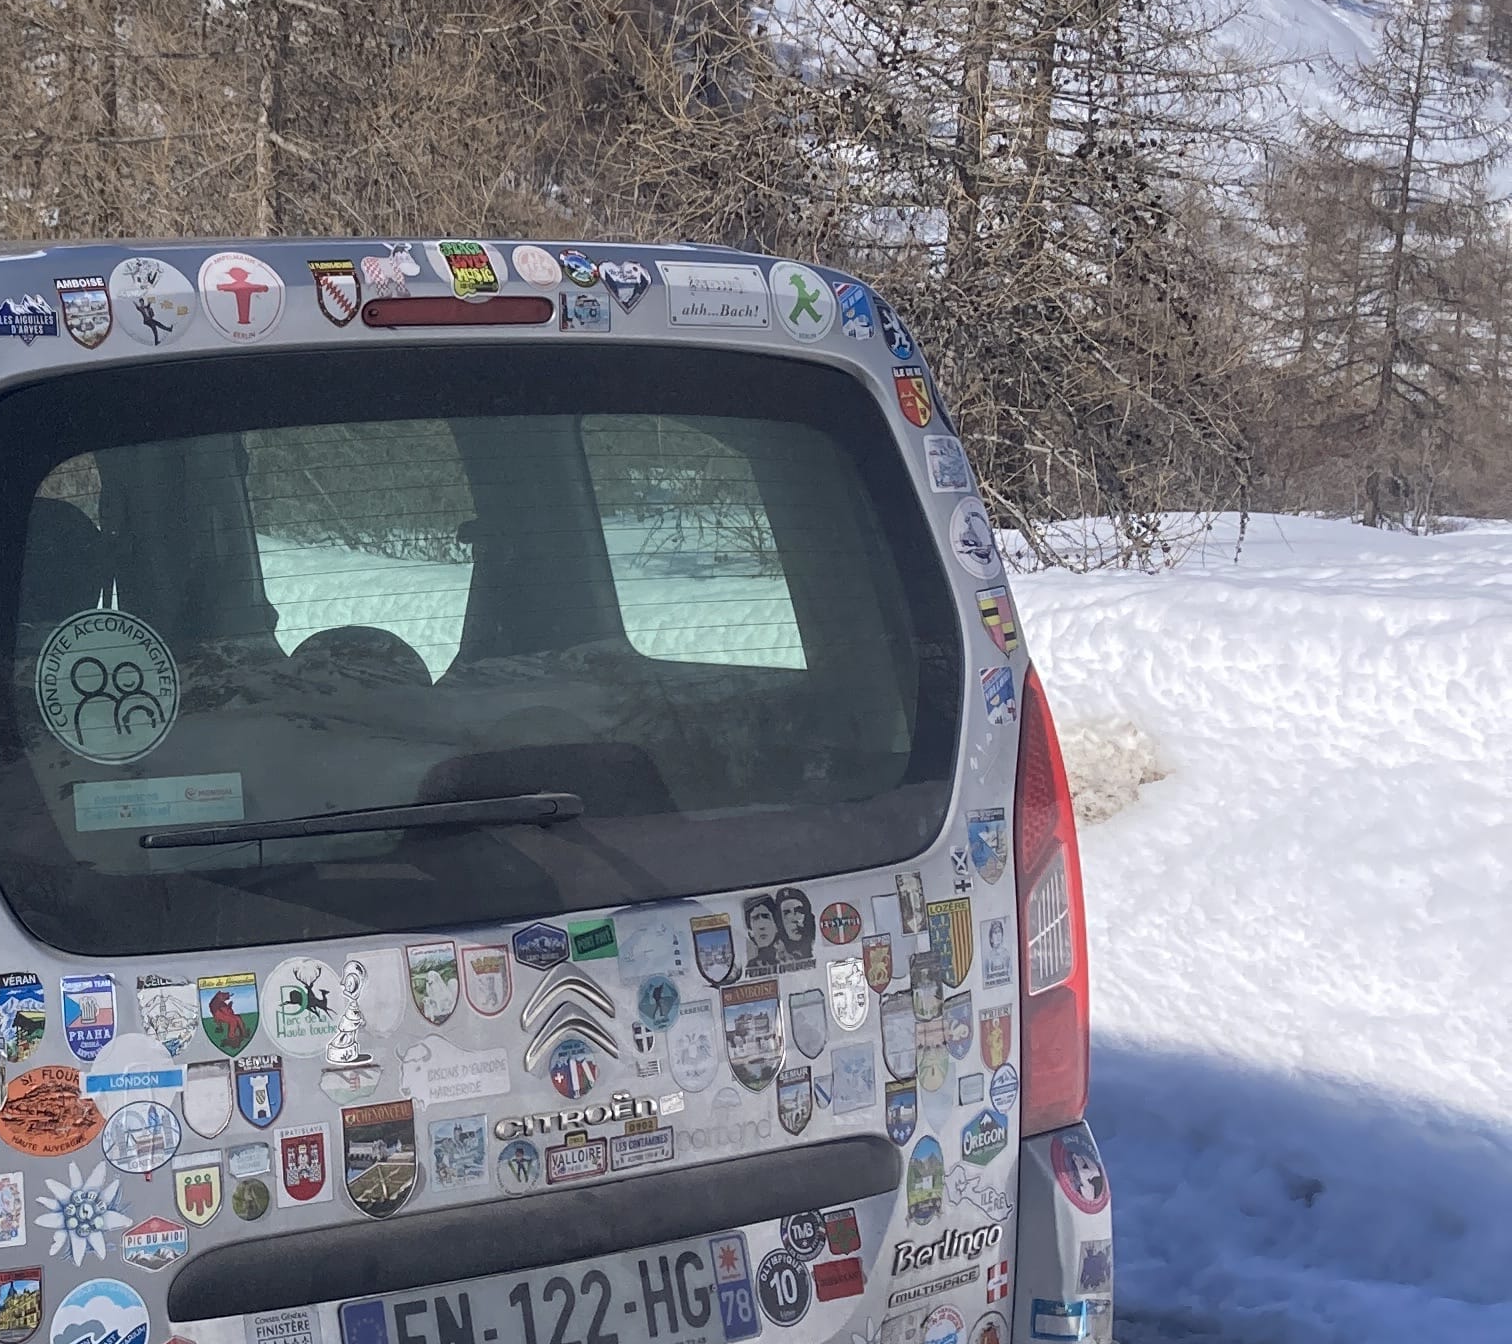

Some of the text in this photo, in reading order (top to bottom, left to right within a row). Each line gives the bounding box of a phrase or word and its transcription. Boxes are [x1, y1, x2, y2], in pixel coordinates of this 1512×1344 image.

[455, 268, 494, 282] MUSIC
[55, 277, 104, 289] AMBOISE
[0, 315, 54, 325] LES AIGUILLES
[11, 325, 44, 335] D'ARVES
[45, 635, 72, 727] CONDUITE
[929, 902, 967, 915] LOZÈRE
[2, 973, 36, 987] VÉRAN
[94, 980, 112, 988] TEAM
[69, 1029, 111, 1041] PRAHA
[42, 1069, 80, 1084] FLOUR
[110, 1074, 159, 1088] LONDON
[280, 1125, 324, 1137] BRATISLAVA
[13, 1136, 86, 1152] HAUTE AUVERGNE
[616, 1142, 627, 1153] LES
[963, 1127, 1005, 1155] OREGON
[551, 1147, 602, 1168] VALLOIRE
[792, 1222, 814, 1240] TMB
[127, 1231, 183, 1247] PIC DU MIDI
[892, 1224, 1003, 1276] Berlingo
[760, 1255, 803, 1282] OLYMPIQUE
[770, 1269, 797, 1306] 10
[895, 1271, 977, 1303] MULTISPACE
[721, 1288, 752, 1326] 78
[256, 1320, 310, 1338] FINISTÈRE
